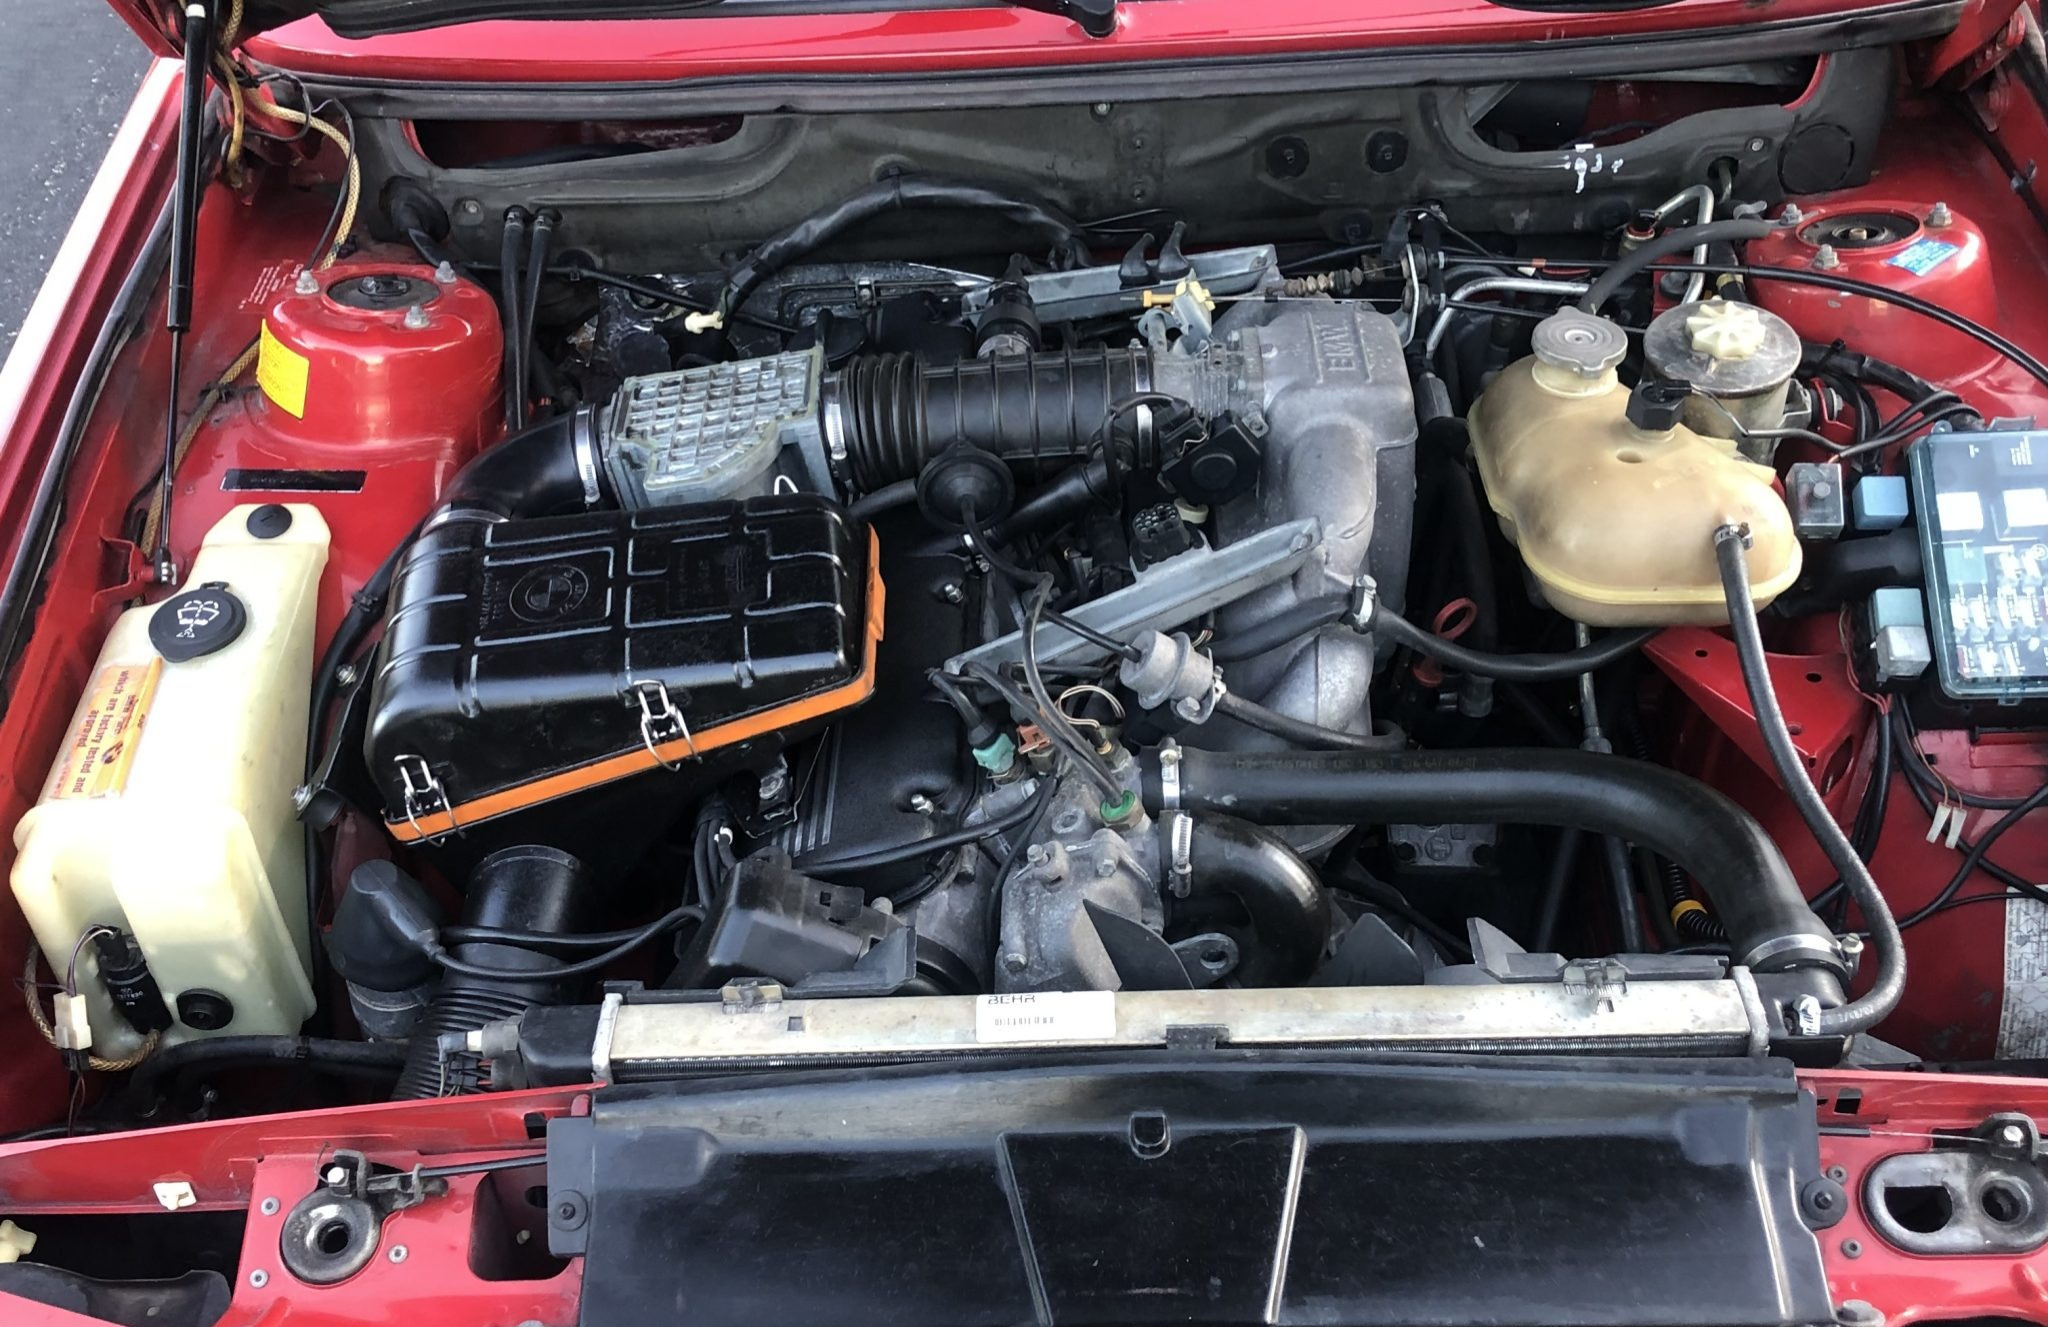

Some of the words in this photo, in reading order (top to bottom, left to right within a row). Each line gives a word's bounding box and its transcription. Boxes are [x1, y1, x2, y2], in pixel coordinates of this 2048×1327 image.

[1320, 323, 1357, 371] BMW
[113, 670, 129, 694] which
[106, 697, 119, 711] are
[77, 709, 99, 748] approved
[91, 714, 114, 743] factory
[80, 747, 100, 773] tested
[72, 777, 86, 793] and
